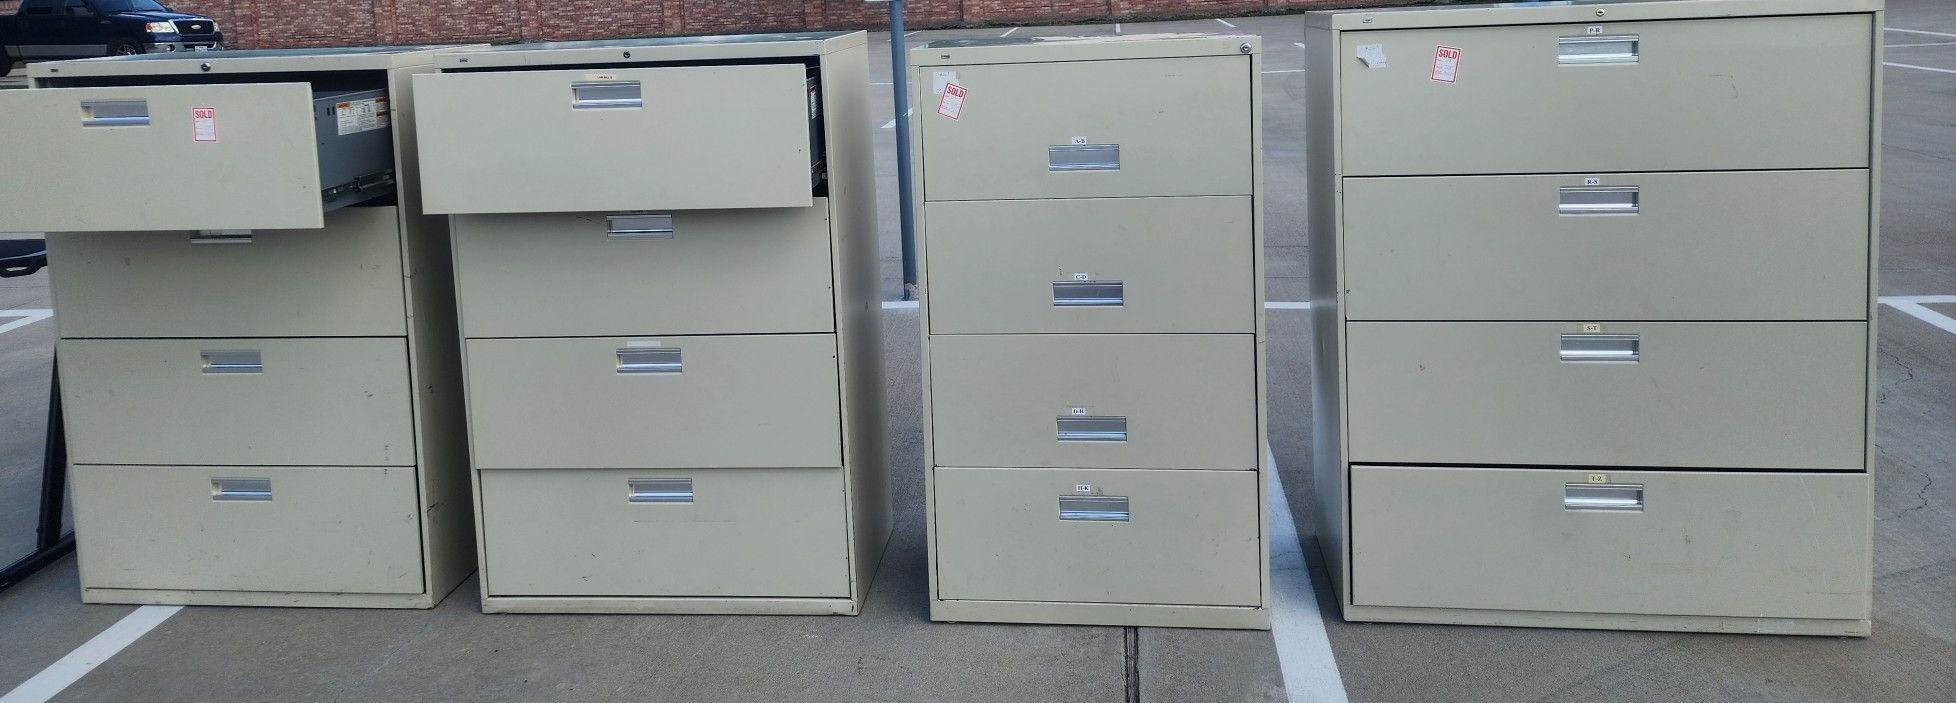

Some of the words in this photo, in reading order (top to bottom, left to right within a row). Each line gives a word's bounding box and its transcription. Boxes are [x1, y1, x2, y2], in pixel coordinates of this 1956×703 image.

[1438, 49, 1458, 59] SOLD
[946, 86, 964, 98] SOLD
[194, 110, 213, 119] SOLD
